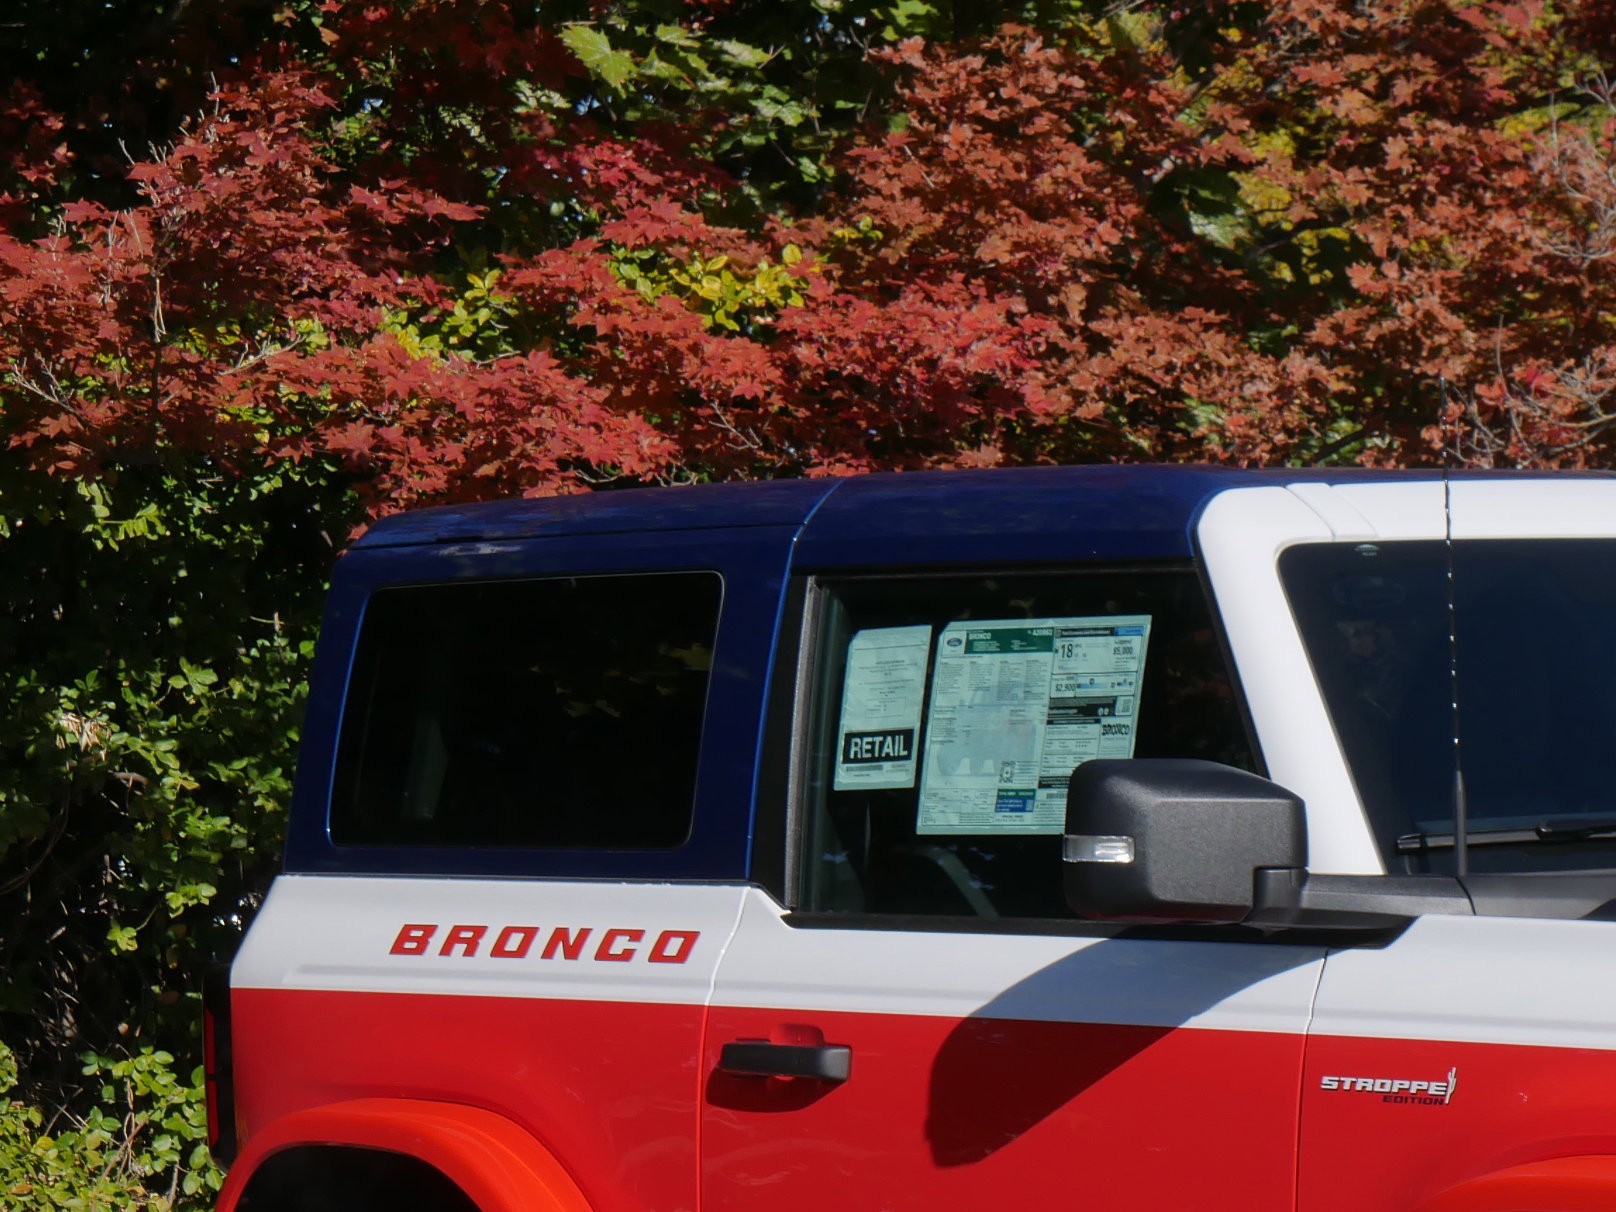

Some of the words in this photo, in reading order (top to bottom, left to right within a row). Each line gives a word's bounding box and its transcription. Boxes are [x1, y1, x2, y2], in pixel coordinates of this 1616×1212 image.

[1060, 643, 1074, 659] 18
[1101, 722, 1131, 736] BRONCO
[849, 734, 908, 760] RETAIL
[389, 923, 701, 964] BRONCO
[1321, 1076, 1448, 1095] STROPPE
[1383, 1096, 1444, 1106] EDITION
